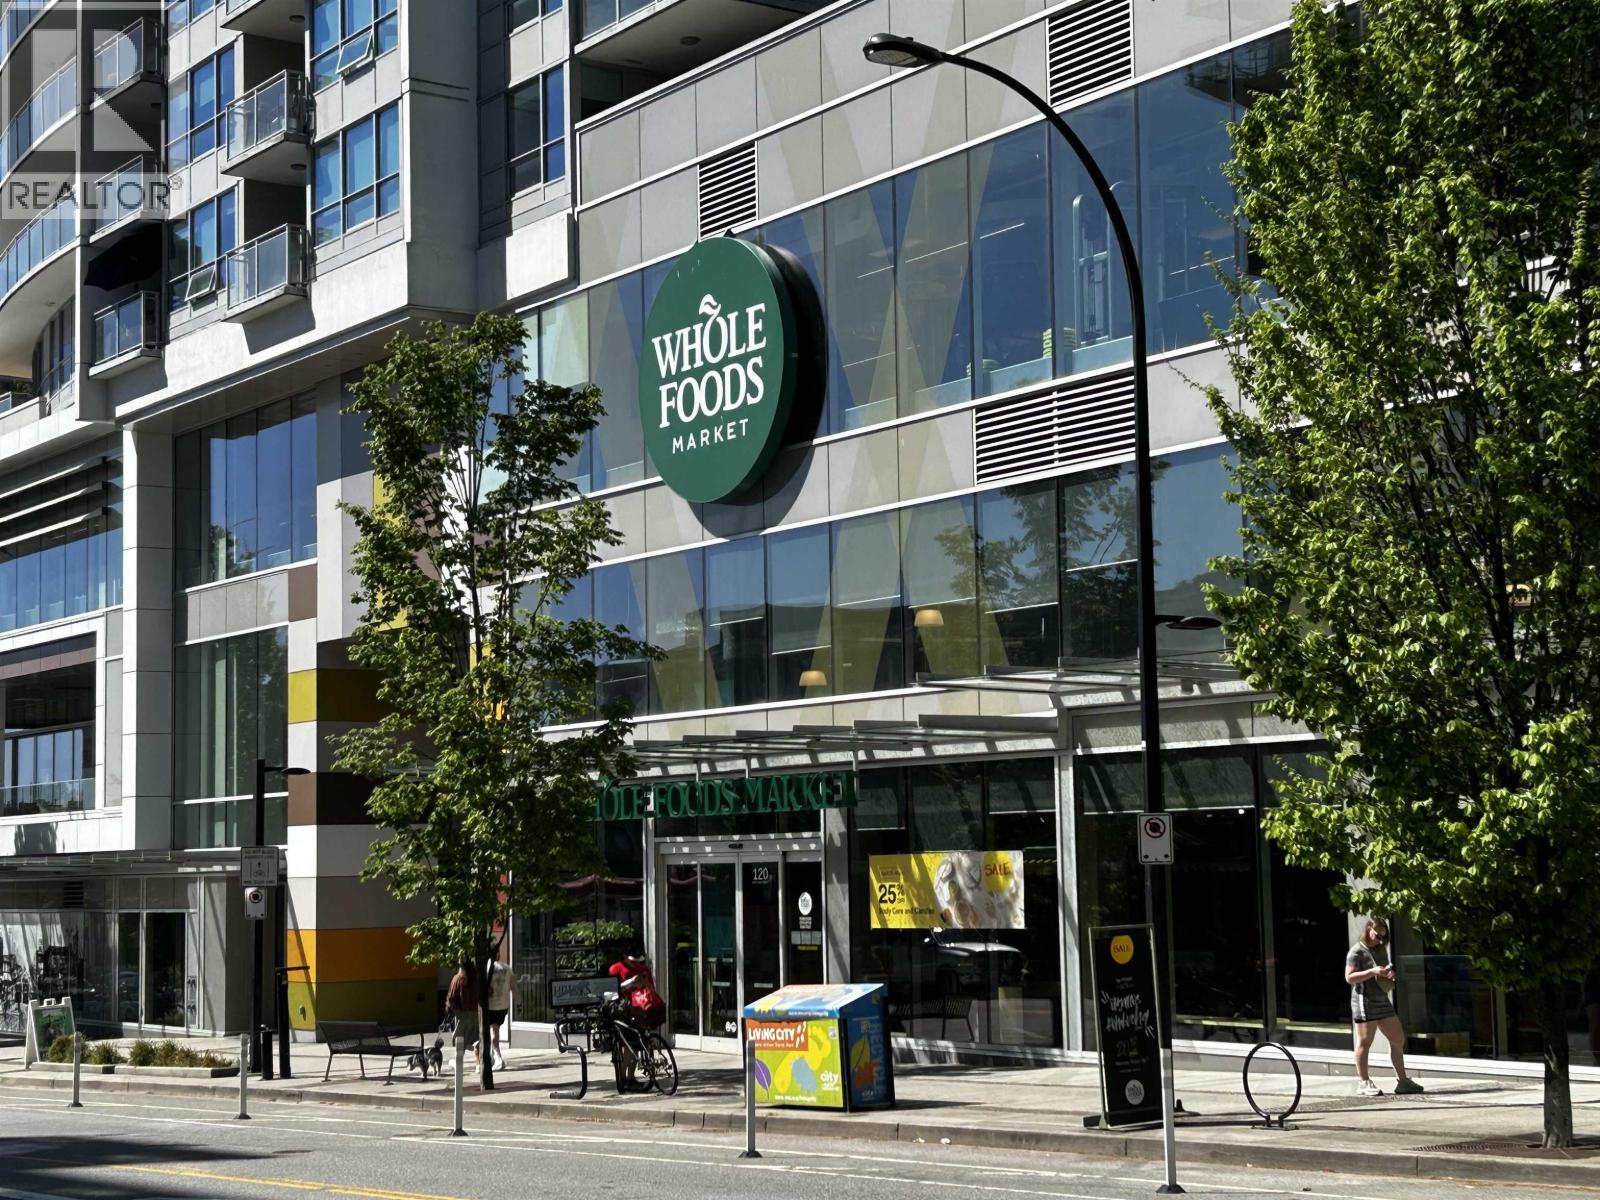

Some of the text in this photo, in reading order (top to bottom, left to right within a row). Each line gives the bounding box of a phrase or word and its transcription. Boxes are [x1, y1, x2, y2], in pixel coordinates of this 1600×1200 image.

[651, 294, 767, 378] WHOLE
[659, 356, 765, 428] FOODS
[672, 418, 749, 454] MARKET
[653, 779, 735, 818] FOODS
[752, 867, 769, 880] 120
[985, 863, 1010, 876] SALE
[748, 1028, 796, 1040] LIVING CITY
